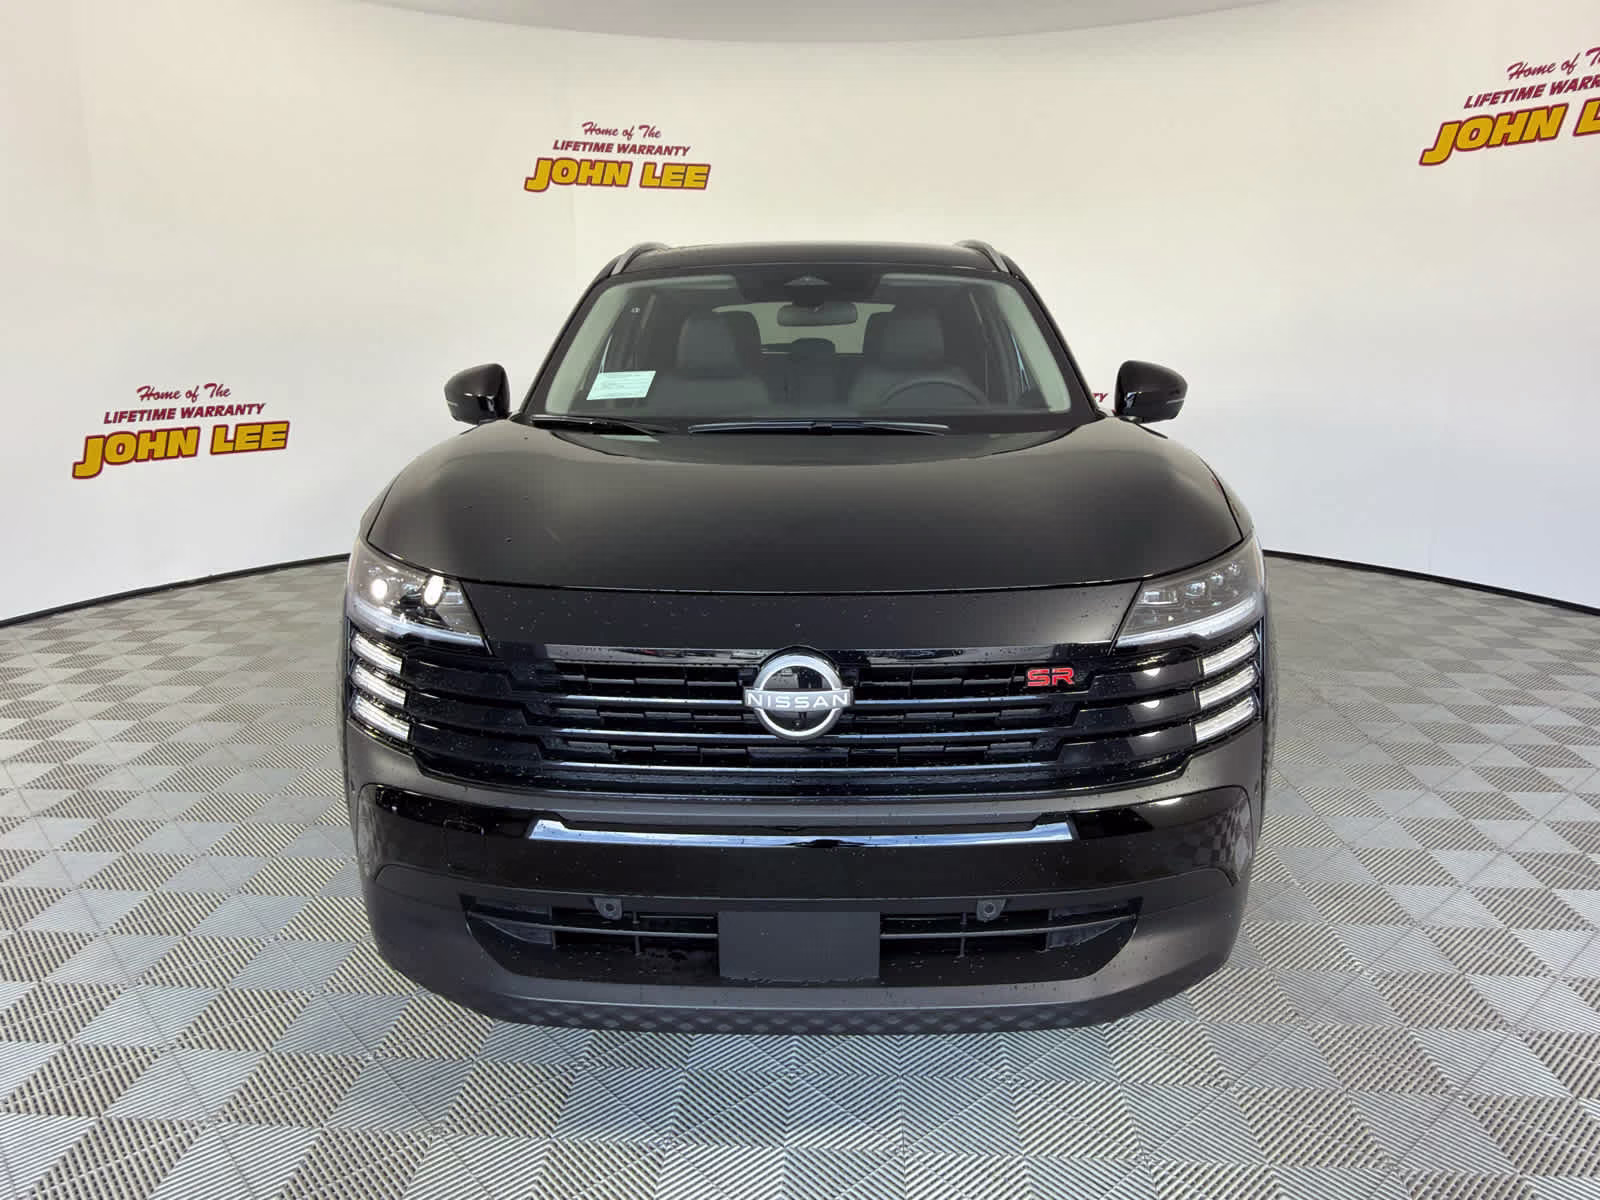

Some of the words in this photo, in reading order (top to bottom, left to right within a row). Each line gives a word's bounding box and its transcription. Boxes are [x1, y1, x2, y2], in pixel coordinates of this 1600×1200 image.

[1507, 62, 1556, 80] Home
[1561, 53, 1580, 75] of
[1464, 84, 1547, 109] LIFETIME
[1549, 74, 1600, 96] WARR
[582, 121, 618, 136] Home
[622, 123, 634, 140] of
[639, 125, 661, 138] The
[1419, 103, 1569, 166] JOHN
[553, 140, 614, 153] LIFETIME
[617, 143, 690, 157] WARRANTY
[524, 157, 633, 192] JOHN
[639, 162, 711, 190] LEE
[137, 385, 181, 401] Home
[185, 385, 199, 403] of
[204, 383, 231, 399] The
[104, 407, 176, 424] LIFETIME
[180, 403, 265, 419] WARRANTY
[72, 427, 201, 479] JOHN
[210, 420, 290, 455] LEE
[1027, 668, 1075, 687] SR
[747, 692, 849, 708] NISSAN
